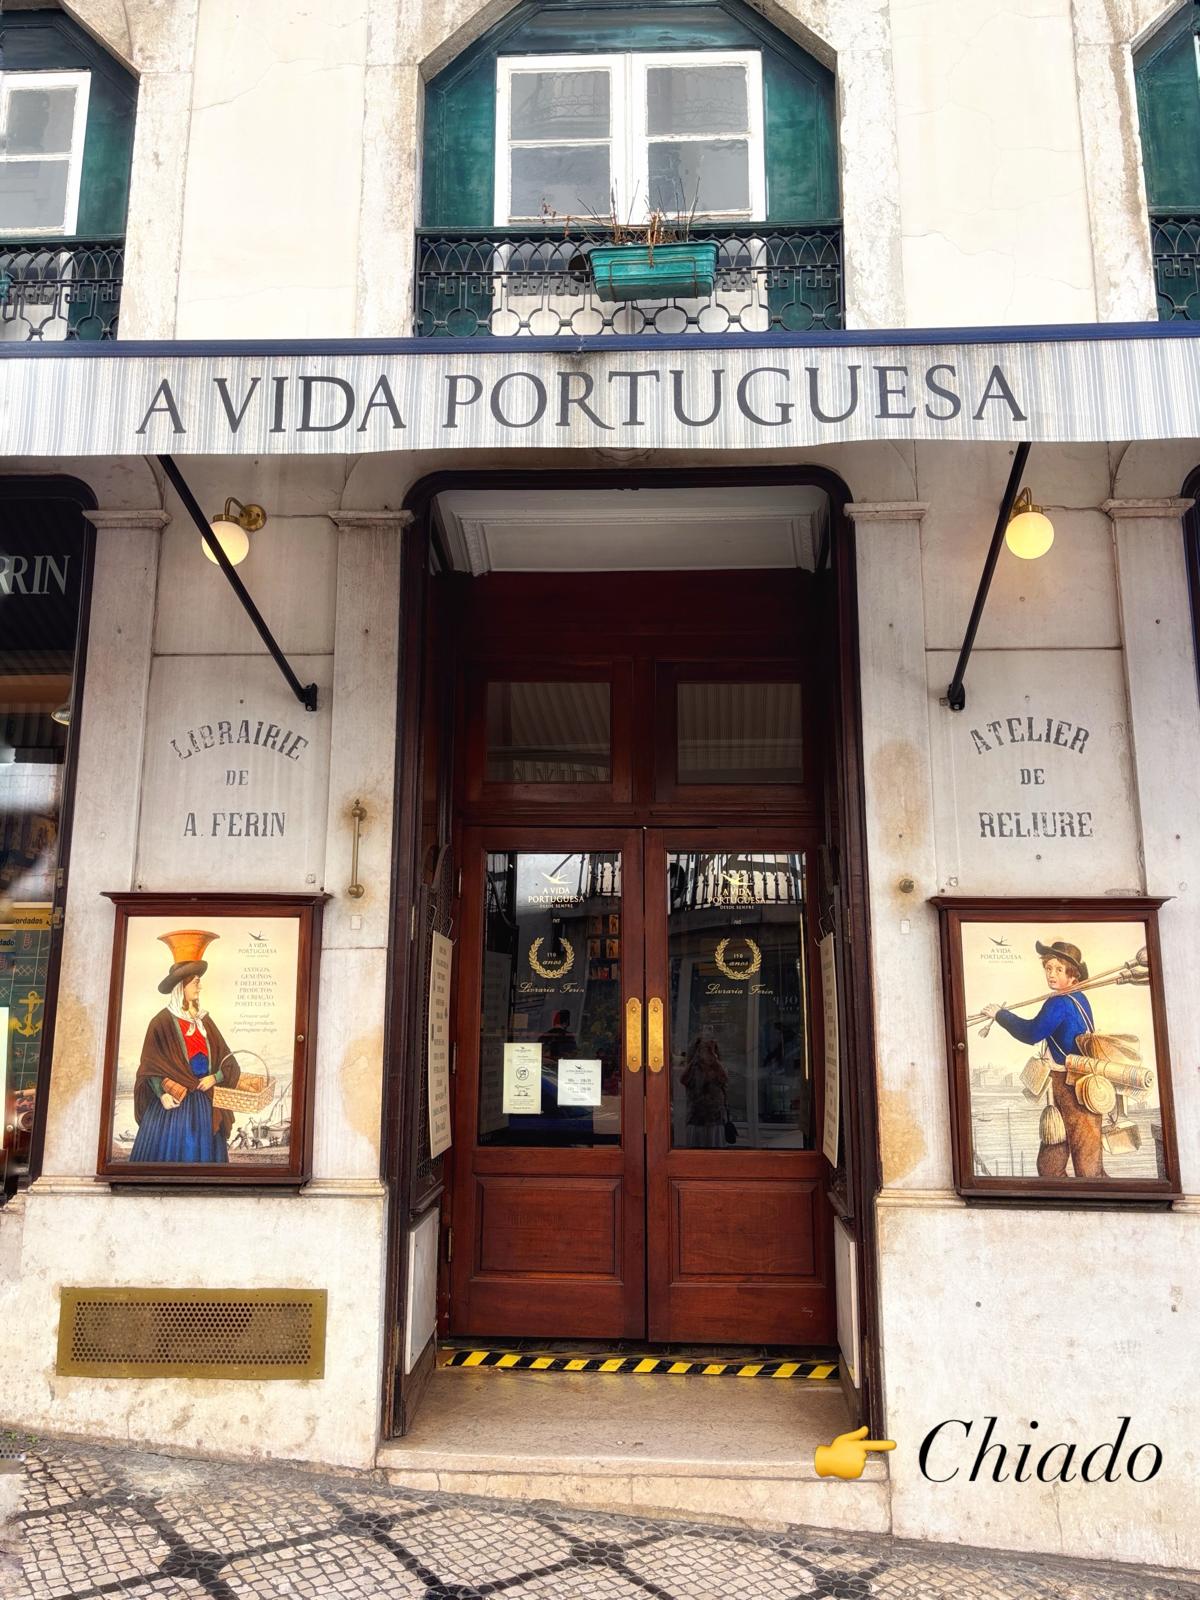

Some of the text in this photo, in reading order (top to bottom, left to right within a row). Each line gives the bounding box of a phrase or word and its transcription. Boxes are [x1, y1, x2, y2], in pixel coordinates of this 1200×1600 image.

[136, 364, 1028, 434] A VIDA PORTUGUESA
[170, 720, 309, 760] LIBRAIRIE
[970, 717, 1090, 754] ATELIER
[226, 770, 249, 786] DE
[1020, 768, 1045, 785] DE
[211, 812, 286, 837] FERIN
[979, 812, 1093, 838] RELIURE
[528, 895, 585, 903] PORTUGUESA
